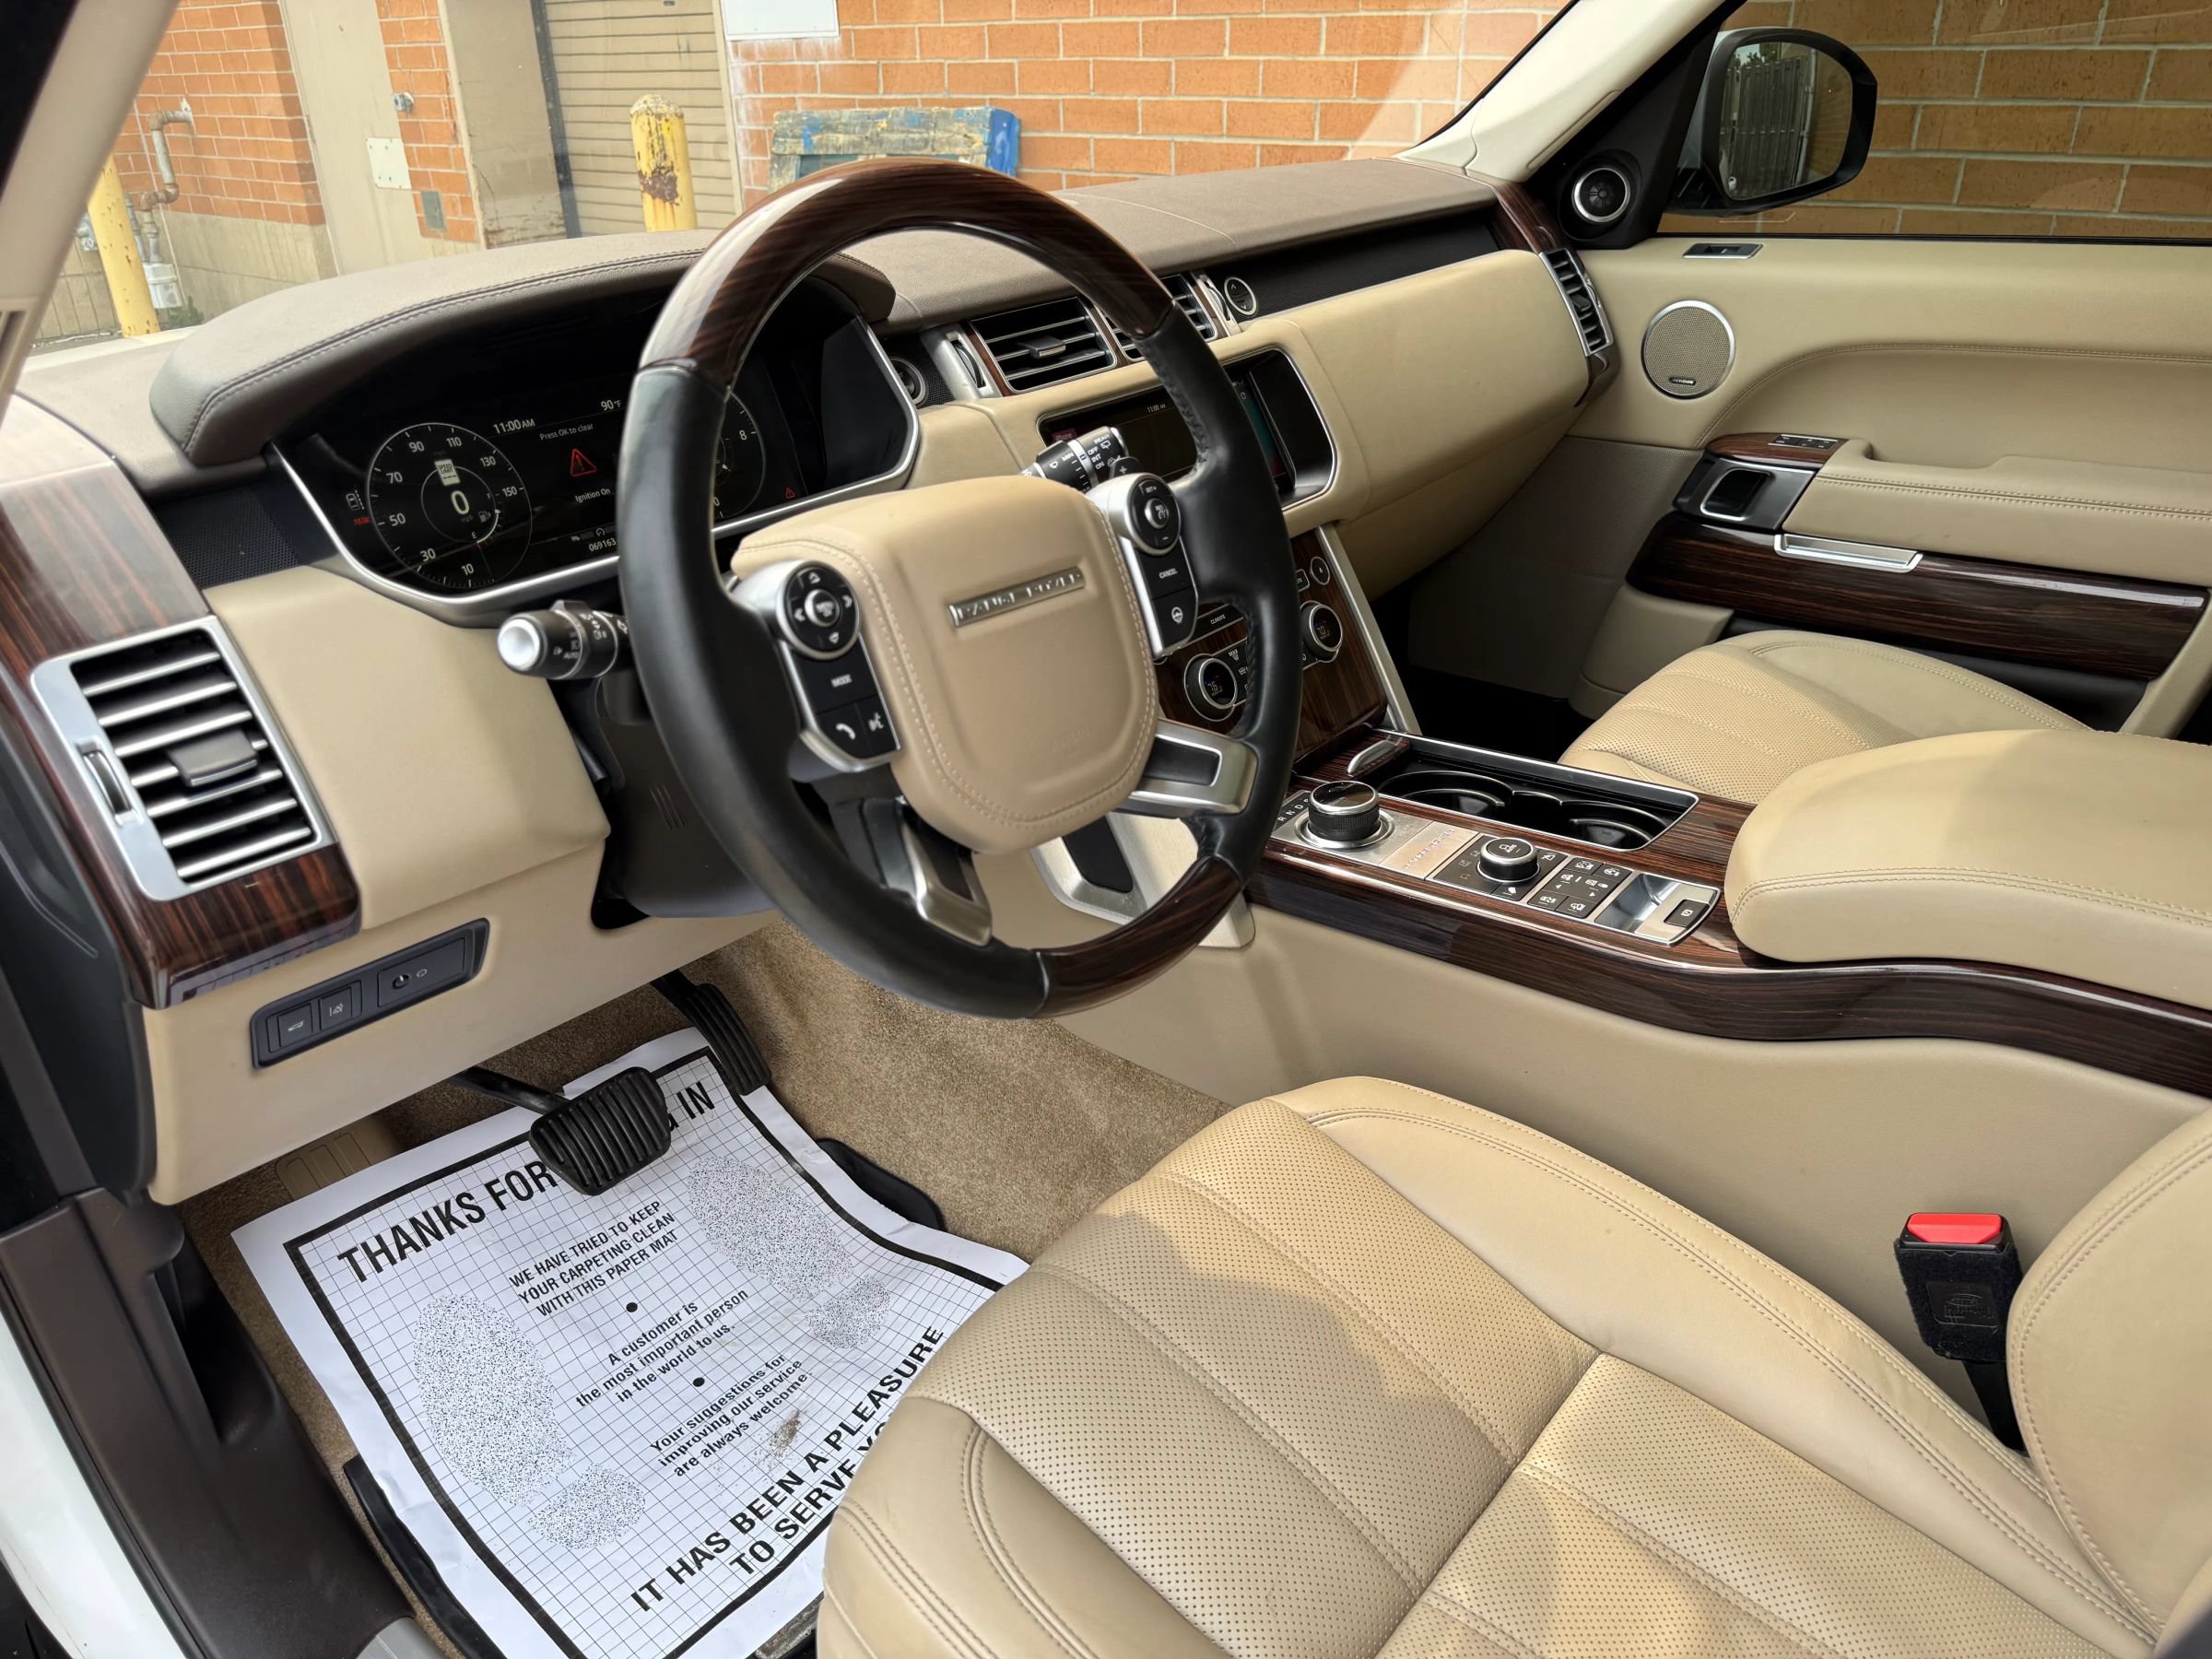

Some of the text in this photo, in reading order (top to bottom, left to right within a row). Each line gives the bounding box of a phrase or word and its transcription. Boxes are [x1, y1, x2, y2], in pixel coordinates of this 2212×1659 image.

[540, 431, 559, 441] Press
[559, 427, 569, 436] OK
[577, 423, 594, 432] clear
[739, 429, 747, 441] 8
[408, 441, 425, 453] 90
[446, 437, 463, 447] 110
[1062, 452, 1074, 462] MIN
[1088, 446, 1099, 455] OFF
[480, 455, 497, 467] 130
[1091, 453, 1101, 463] INT
[1095, 461, 1105, 470] ON
[386, 471, 403, 484] 70
[502, 486, 517, 498] 150
[575, 488, 611, 503] Ignition On
[451, 490, 470, 514] 0
[389, 513, 406, 526] 50
[589, 538, 617, 552] 069163
[420, 547, 436, 561] 30
[462, 563, 474, 575] 10
[1159, 568, 1178, 579] CANCEL
[1229, 649, 1239, 657] MAX
[677, 1081, 715, 1120] IN
[338, 1161, 559, 1284] THANKS FOR
[509, 1201, 661, 1288] WE HAVE TRIED TO KEEP
[518, 1212, 676, 1304] YOUR CARPETING CLEAN
[536, 1230, 678, 1316] WITH THIS PAPER MAT
[607, 1301, 699, 1366] A customer is
[575, 1290, 748, 1407] the most important person
[616, 1324, 735, 1403] in the world to us.
[650, 1355, 787, 1453] Your suggestions for
[658, 1359, 803, 1467] improving our service
[674, 1372, 813, 1477] are always welcome.
[630, 1578, 664, 1612] IT
[665, 1532, 731, 1584] HAS
[729, 1470, 805, 1535] BEEN
[804, 1452, 829, 1473] A
[823, 1325, 945, 1452] PLEASURE
[729, 1540, 775, 1575] TO
